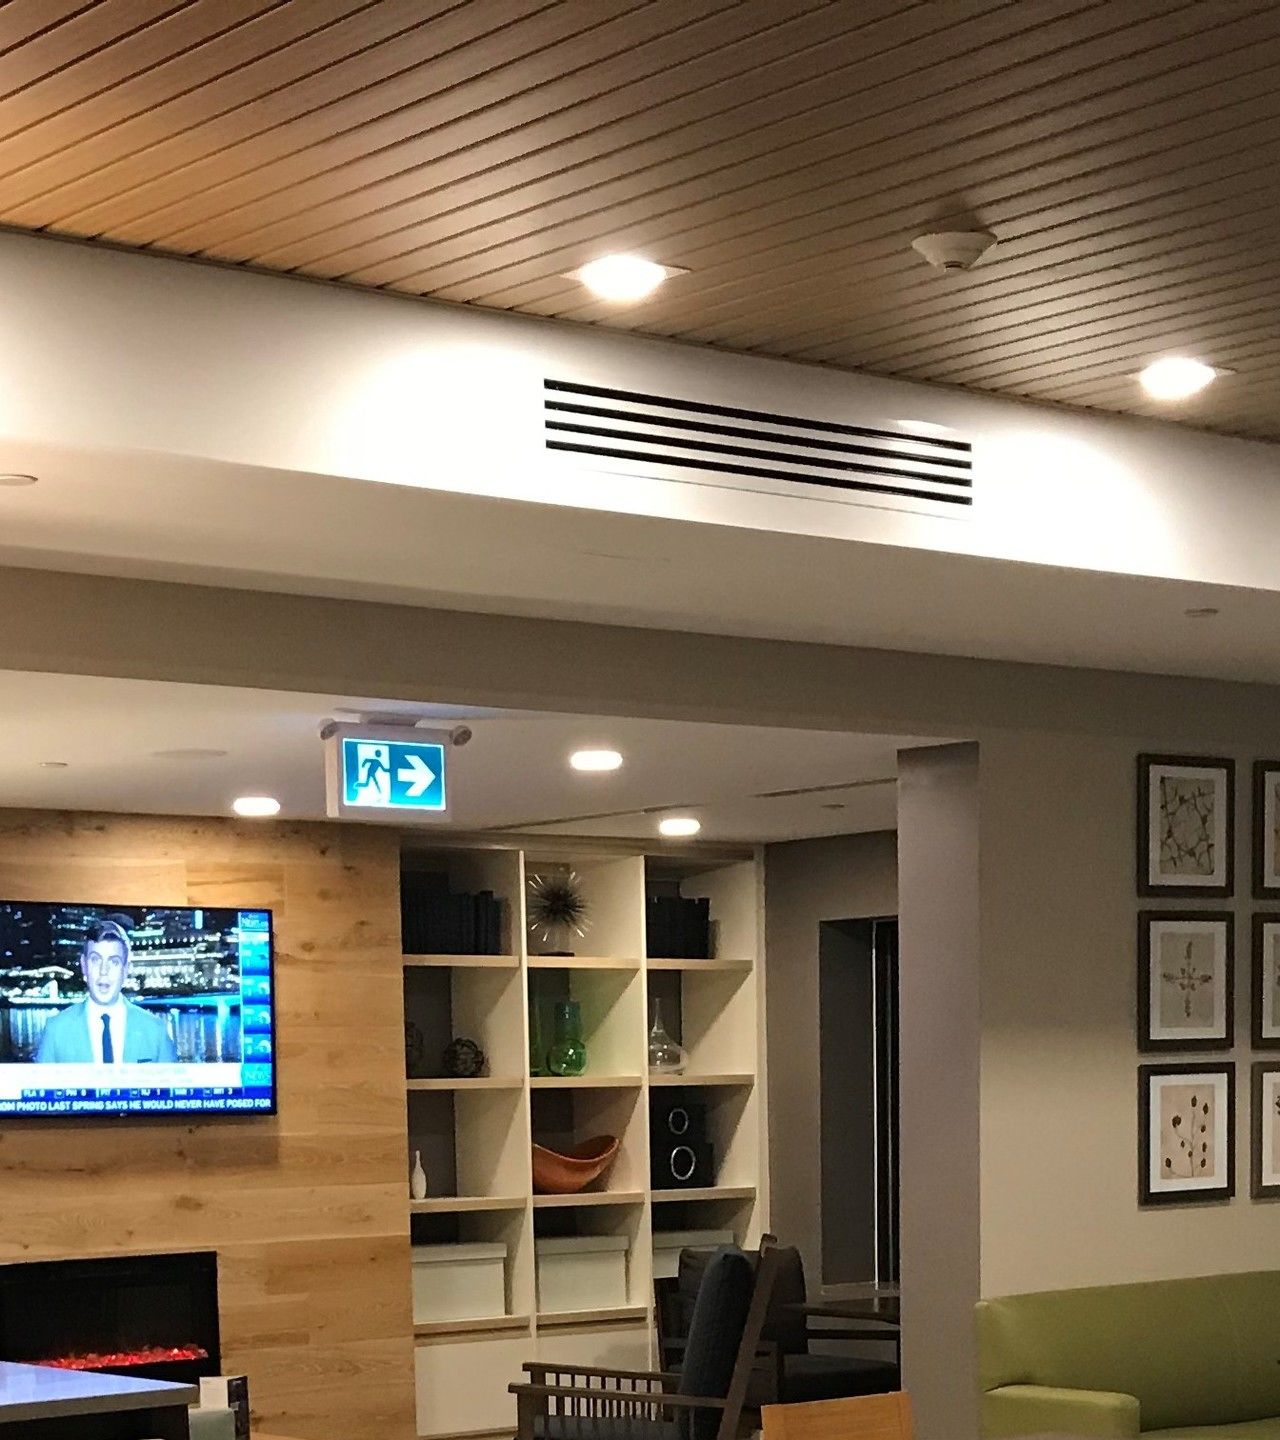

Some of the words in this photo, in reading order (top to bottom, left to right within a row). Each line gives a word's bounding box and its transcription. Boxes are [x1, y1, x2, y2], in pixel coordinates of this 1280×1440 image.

[16, 1101, 47, 1111] PHOTO
[48, 1101, 70, 1111] LAST
[72, 1100, 104, 1110] SPRING
[105, 1100, 128, 1110] SAYS
[142, 1100, 174, 1110] WOULD
[174, 1099, 202, 1109] NEVER
[203, 1099, 225, 1108] HAVE
[255, 1098, 271, 1107] FOR
